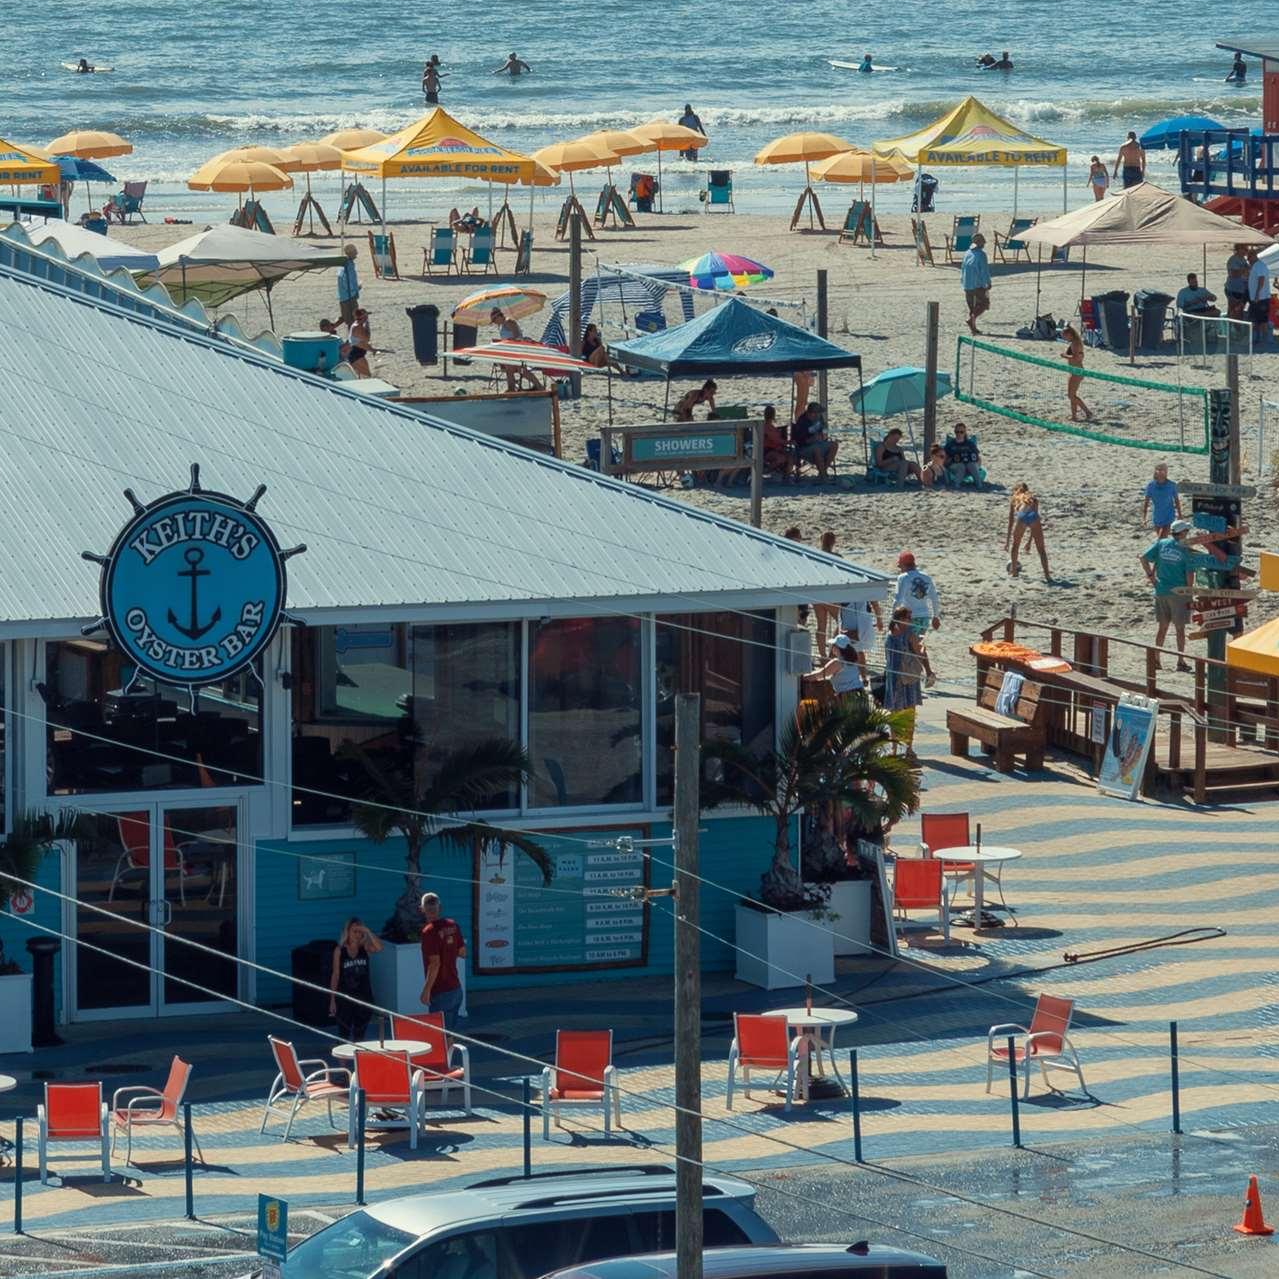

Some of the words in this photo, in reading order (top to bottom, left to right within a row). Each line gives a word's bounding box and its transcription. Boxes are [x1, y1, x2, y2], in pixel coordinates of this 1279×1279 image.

[928, 151, 999, 162] AVAILABLE
[1005, 152, 1020, 161] TO
[1024, 151, 1058, 162] RENT
[400, 164, 461, 174] AVAILABLE
[464, 164, 488, 173] FOR
[491, 164, 520, 174] RENT
[14, 171, 42, 181] RENT
[655, 439, 713, 451] SHOWERS
[131, 512, 260, 565] KEITH'S
[127, 608, 221, 669] OYSTER
[223, 601, 265, 657] BAR
